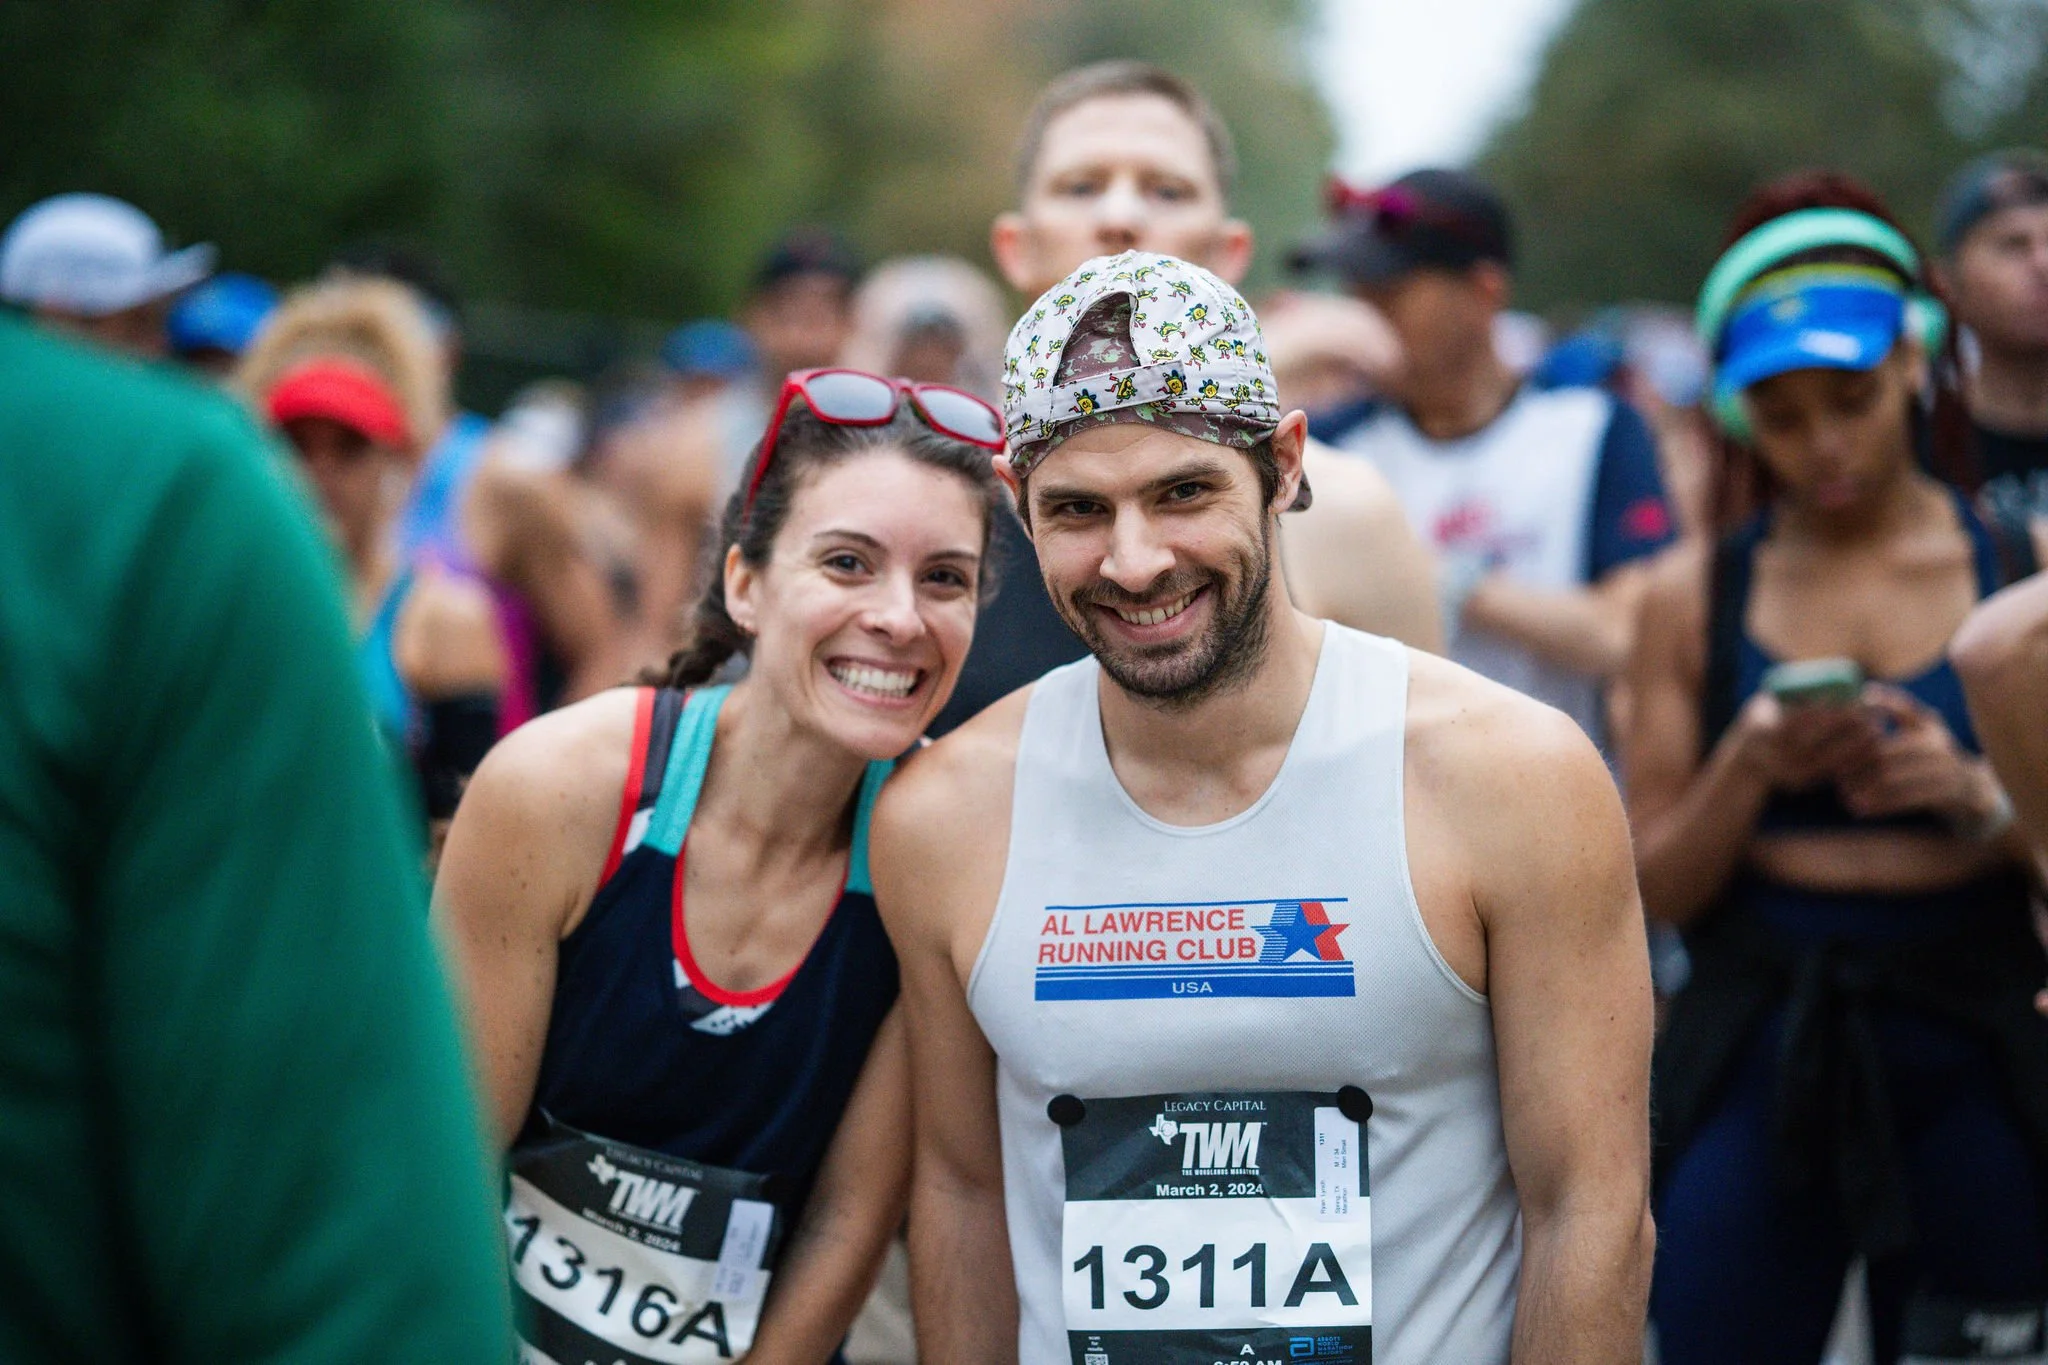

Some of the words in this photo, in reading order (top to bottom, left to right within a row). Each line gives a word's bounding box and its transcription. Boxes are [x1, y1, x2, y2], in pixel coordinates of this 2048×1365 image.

[1041, 914, 1075, 936] AL
[1084, 909, 1245, 935] LAWRENCE
[1037, 938, 1167, 963] RUNNING
[1177, 936, 1257, 961] CLUB
[1172, 981, 1214, 995] USA
[1164, 1101, 1211, 1112] LEGACY
[1214, 1100, 1267, 1111] CAPITAL
[1179, 1122, 1262, 1169] TWM
[1156, 1184, 1205, 1197] March
[1209, 1184, 1223, 1197] 2,
[1227, 1183, 1264, 1195] 2024
[512, 1215, 733, 1359] 1316A
[1073, 1242, 1360, 1310] 1311A
[1240, 1343, 1255, 1356] A
